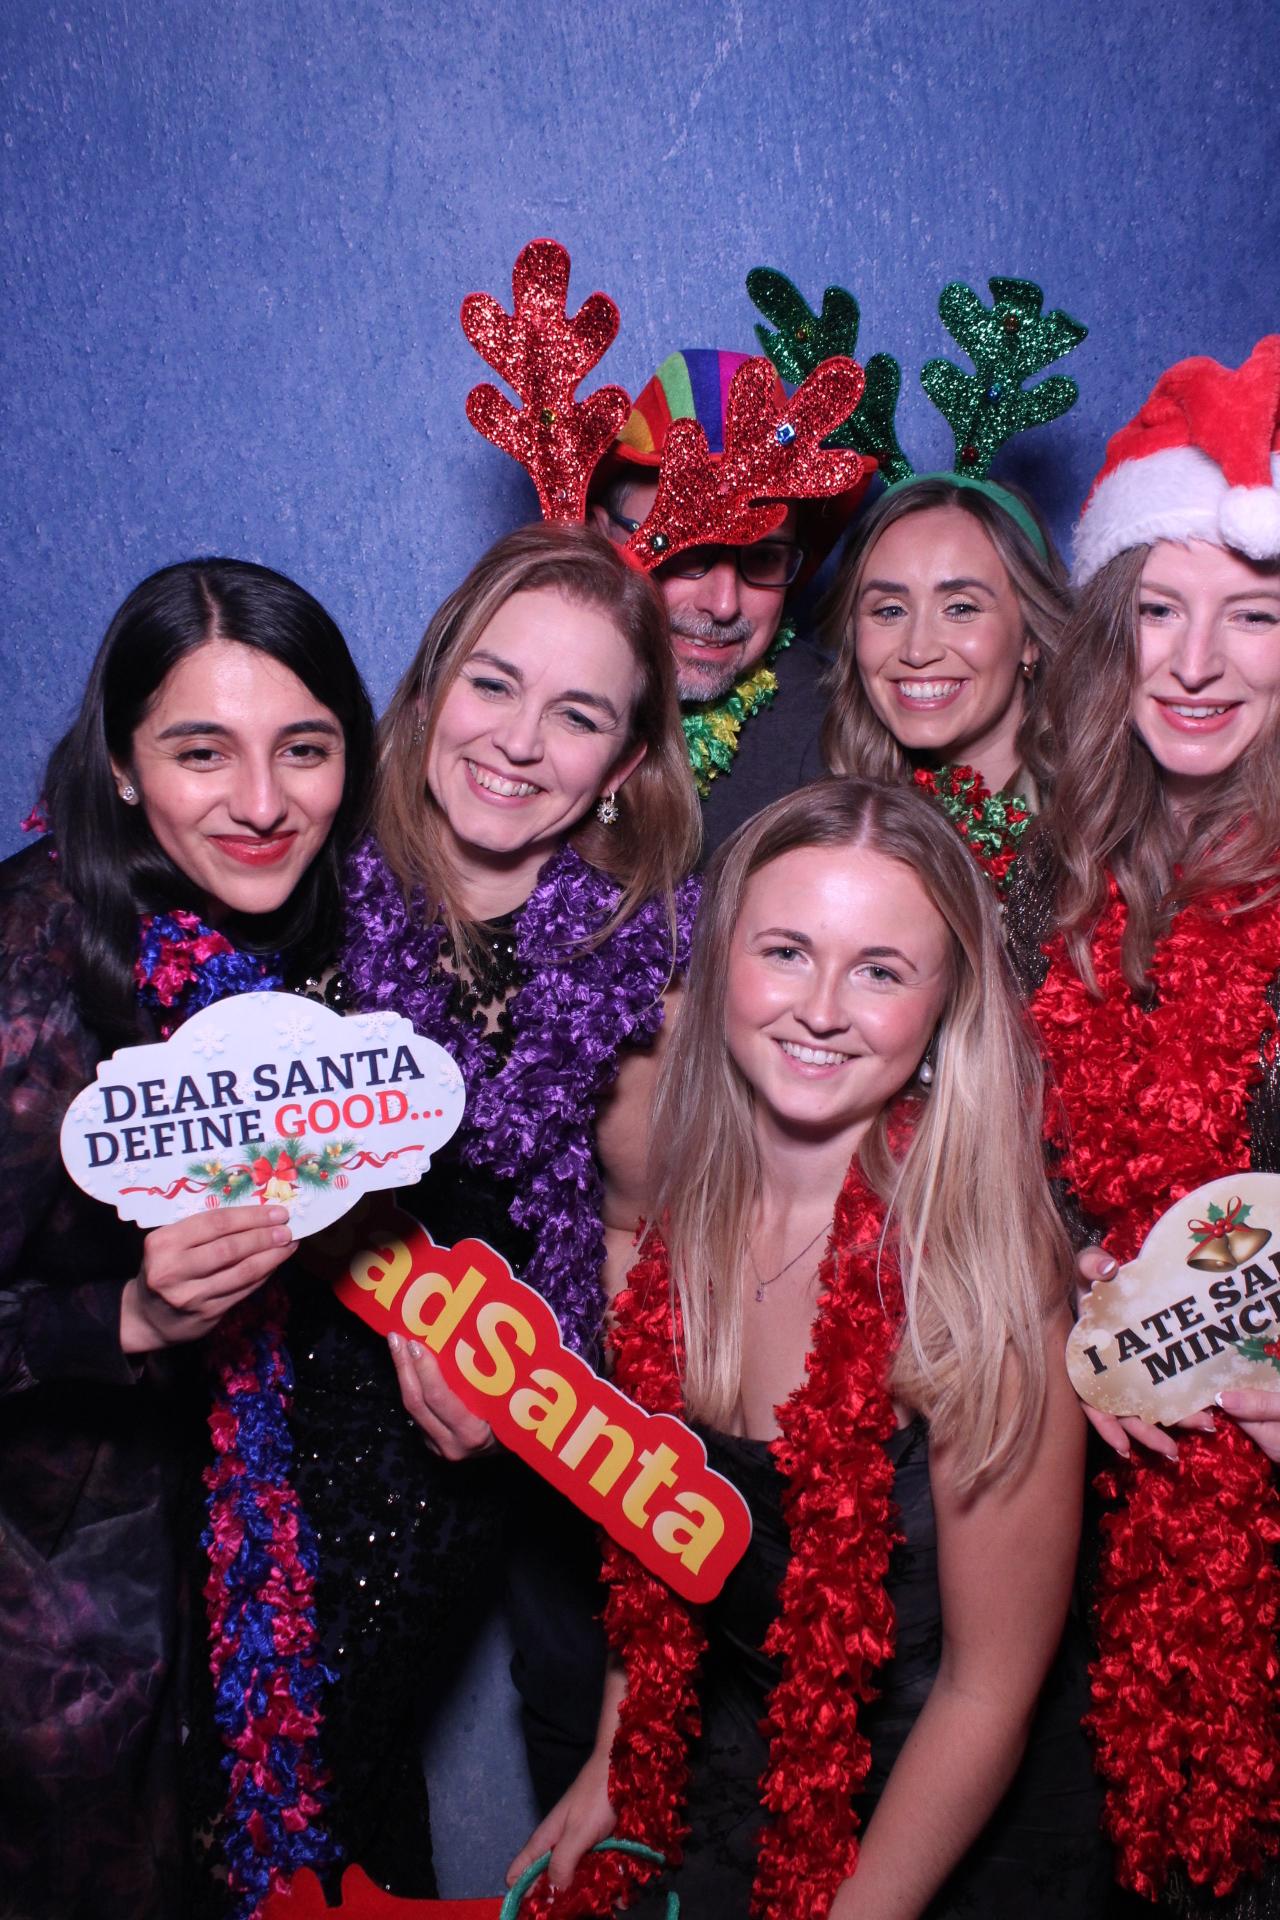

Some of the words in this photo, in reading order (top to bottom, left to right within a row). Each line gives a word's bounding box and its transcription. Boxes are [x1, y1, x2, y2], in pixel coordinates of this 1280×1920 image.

[99, 1069, 244, 1124] DEAR
[253, 1045, 425, 1103] SANTA
[84, 1109, 266, 1168] DEFINE
[274, 1089, 444, 1139] GOOD...
[1083, 1344, 1108, 1375] I
[1114, 1295, 1205, 1363] ATE
